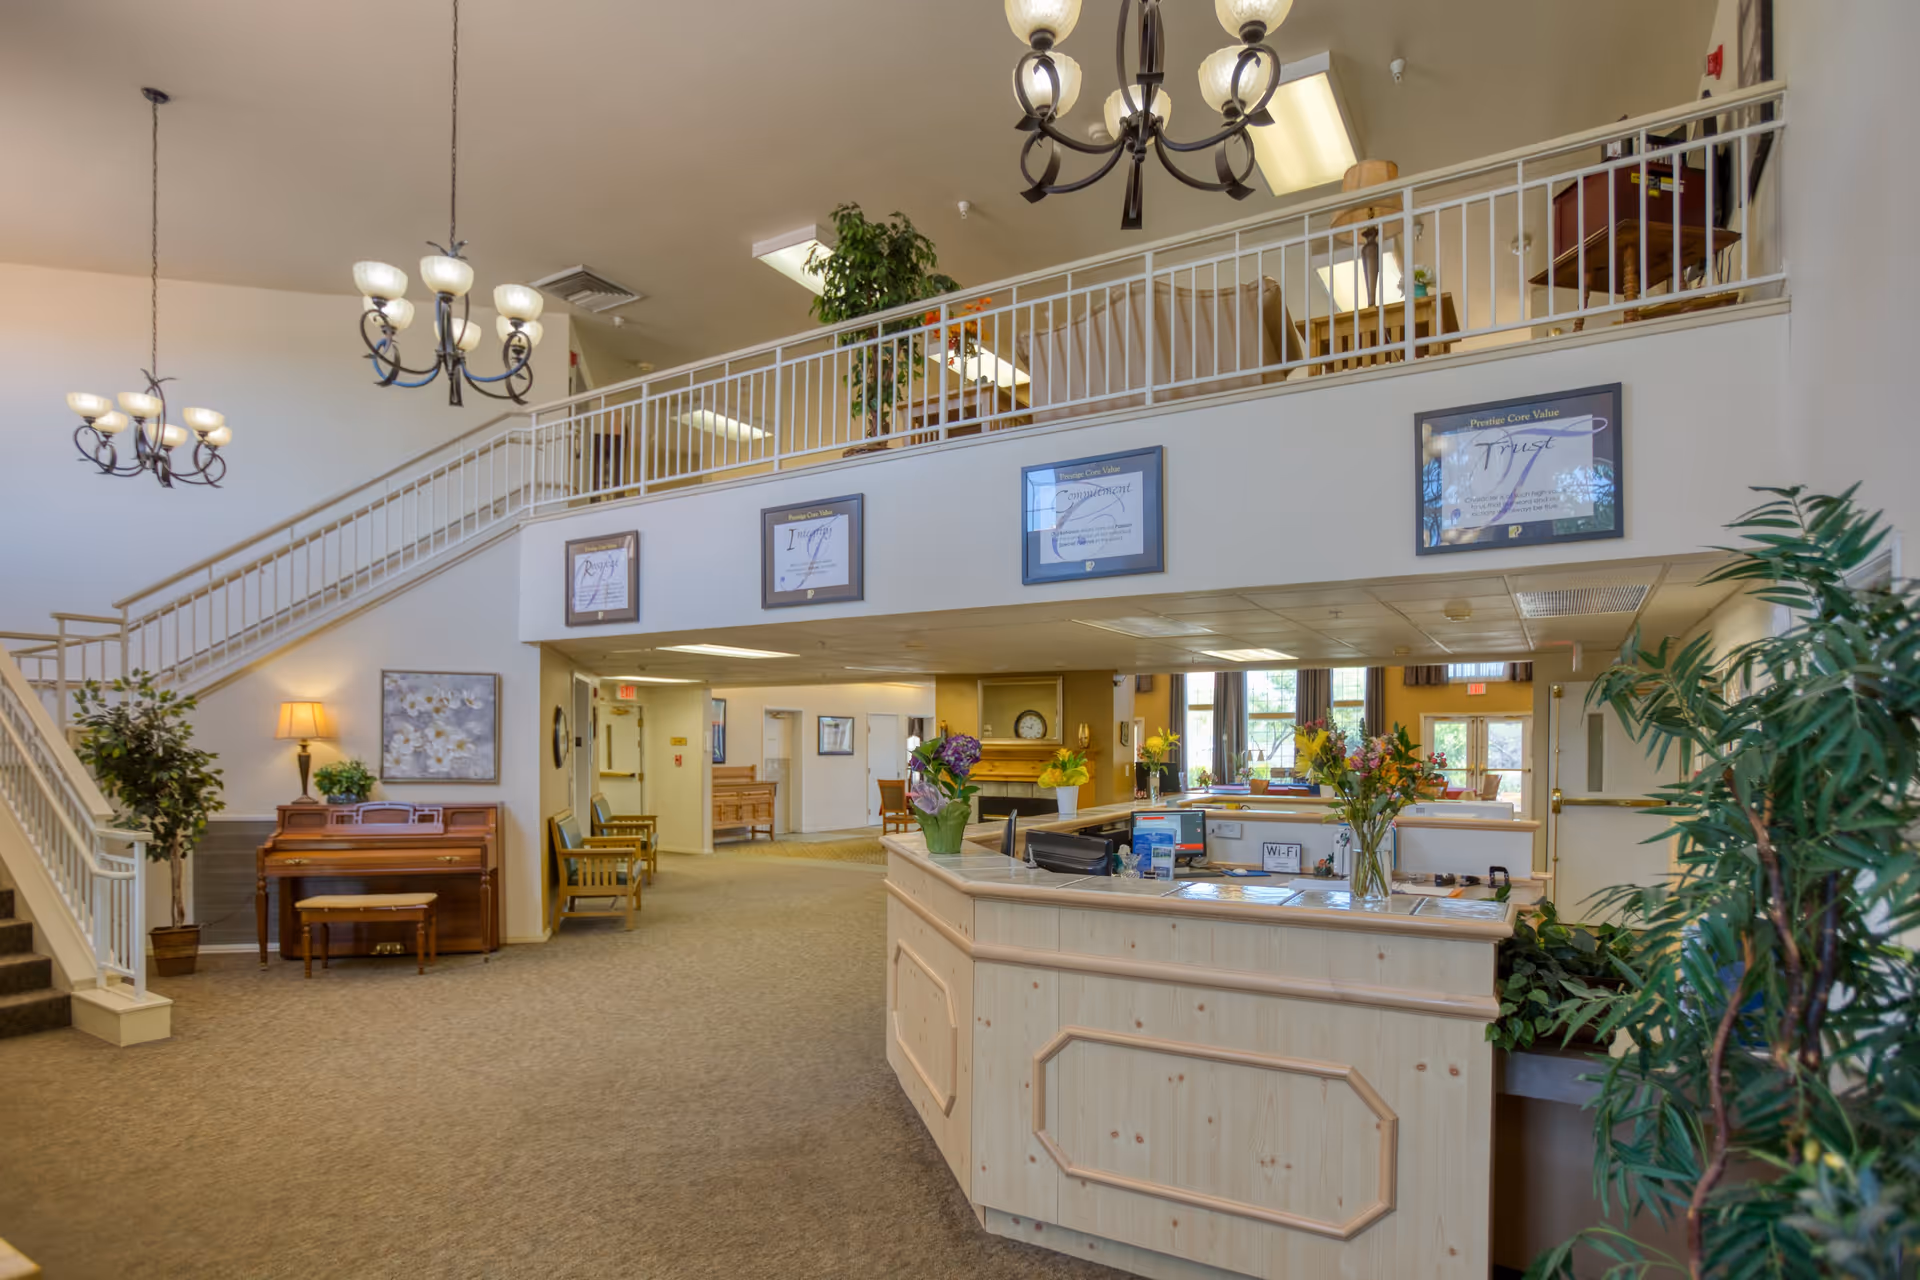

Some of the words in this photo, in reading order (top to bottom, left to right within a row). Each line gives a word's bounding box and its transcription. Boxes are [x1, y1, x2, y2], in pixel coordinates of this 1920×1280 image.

[1470, 416, 1506, 428] Prestige
[1507, 412, 1530, 423] Core
[1532, 408, 1560, 419] Value
[1475, 436, 1557, 471] Trust
[1059, 470, 1085, 481] Prestige
[1085, 469, 1101, 478] Core
[1102, 465, 1121, 474] Value
[1265, 844, 1298, 858] Wi-Fi
